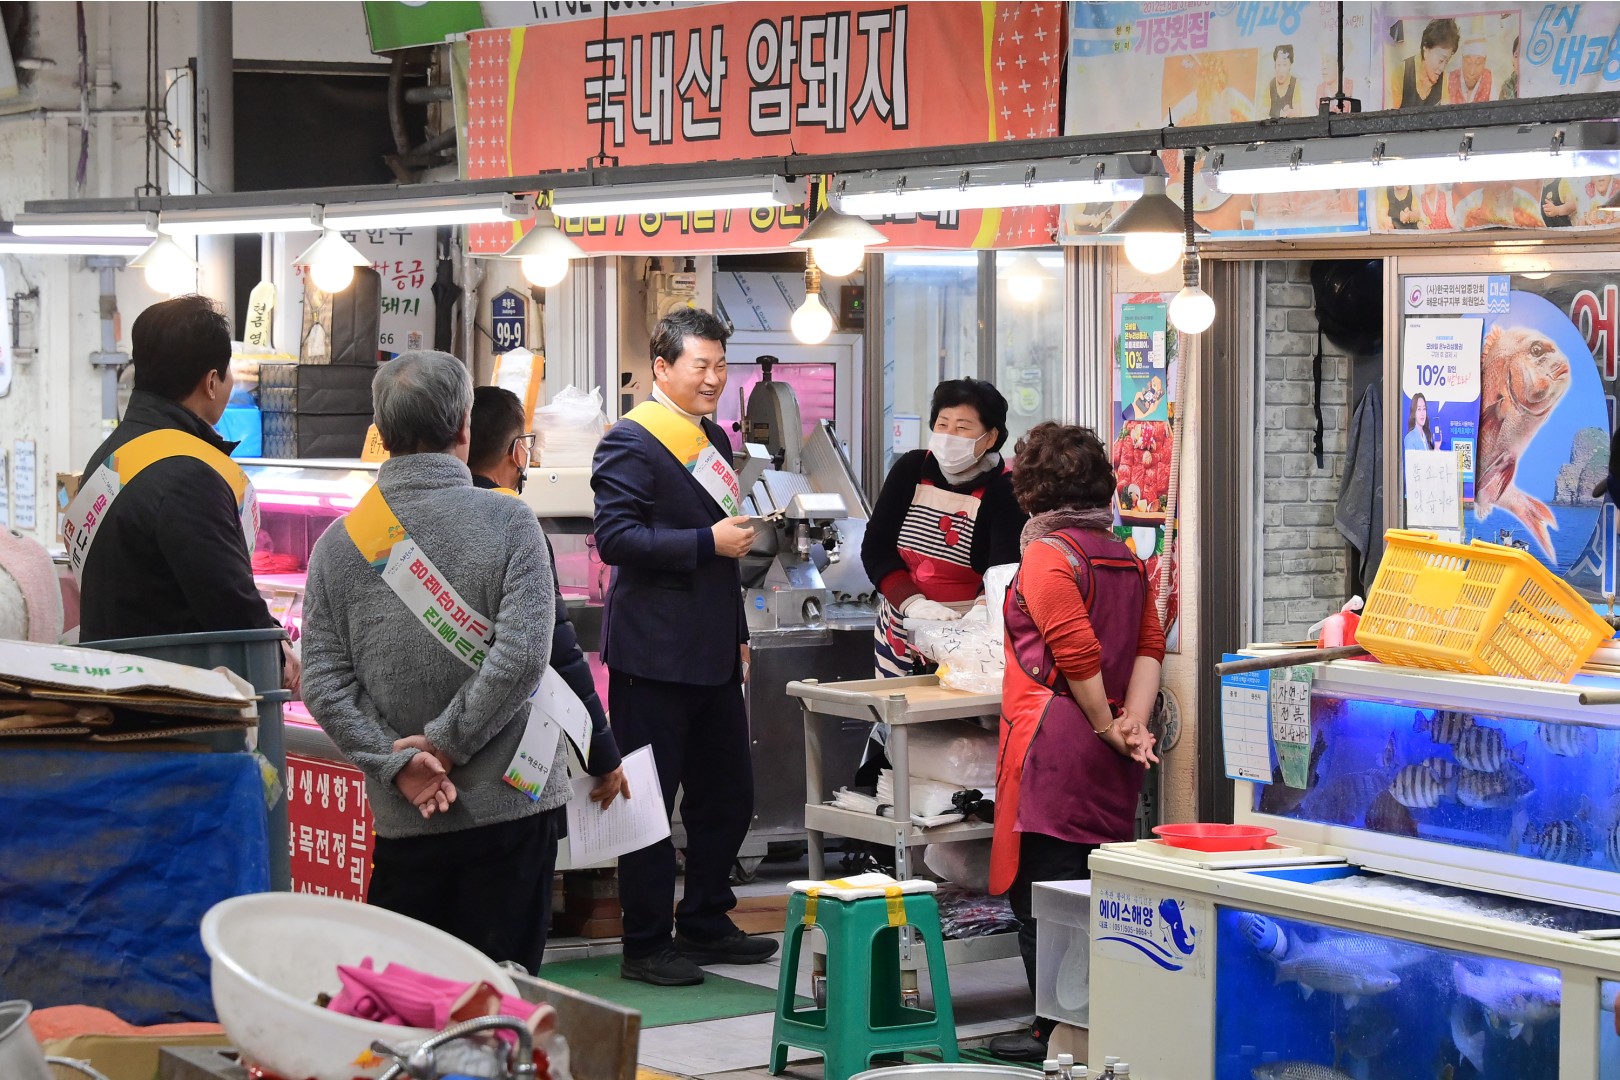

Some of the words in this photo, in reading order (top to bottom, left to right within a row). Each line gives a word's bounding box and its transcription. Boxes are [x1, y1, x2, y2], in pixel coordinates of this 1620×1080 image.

[1134, 10, 1211, 55] 기장횟집
[585, 31, 729, 147] 국내산
[747, 6, 908, 138] 암돼지
[1426, 284, 1485, 295] (사)한국외식업중앙회
[1426, 296, 1460, 308] 해운대구지부
[1462, 296, 1486, 307] 회원업소
[496, 322, 522, 347] 99-9
[1416, 364, 1447, 387] 10%
[1447, 365, 1457, 374] 할인
[527, 755, 549, 775] 해운대구
[1099, 898, 1154, 928] 에이스해양
